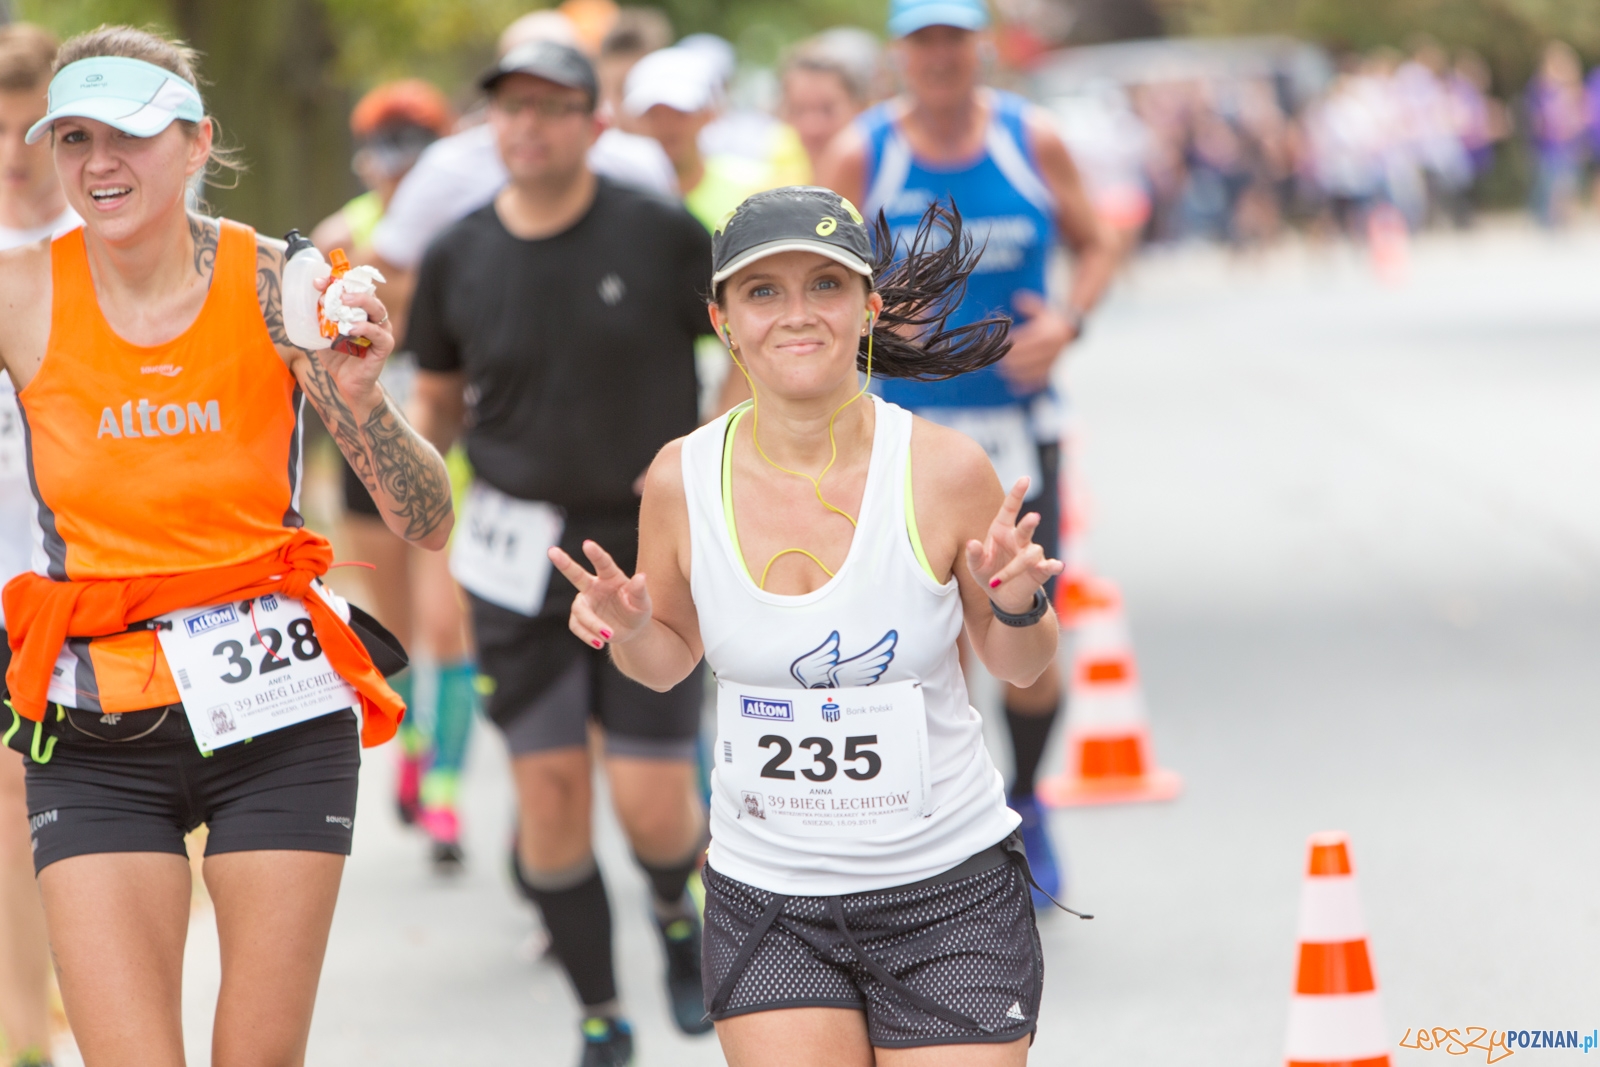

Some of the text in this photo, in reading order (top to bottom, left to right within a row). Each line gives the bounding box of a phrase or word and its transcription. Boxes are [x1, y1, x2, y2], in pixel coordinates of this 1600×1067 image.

[212, 617, 323, 684] 328
[268, 674, 292, 686] ANETA
[234, 697, 253, 711] 39
[255, 686, 288, 705] BIEG
[846, 707, 867, 715] Bank
[869, 704, 893, 714] Polski
[99, 713, 123, 725] 4F
[758, 734, 882, 782] 235
[809, 788, 833, 796] ANNA
[768, 790, 910, 811] 39 BIEG LECHITÓW
